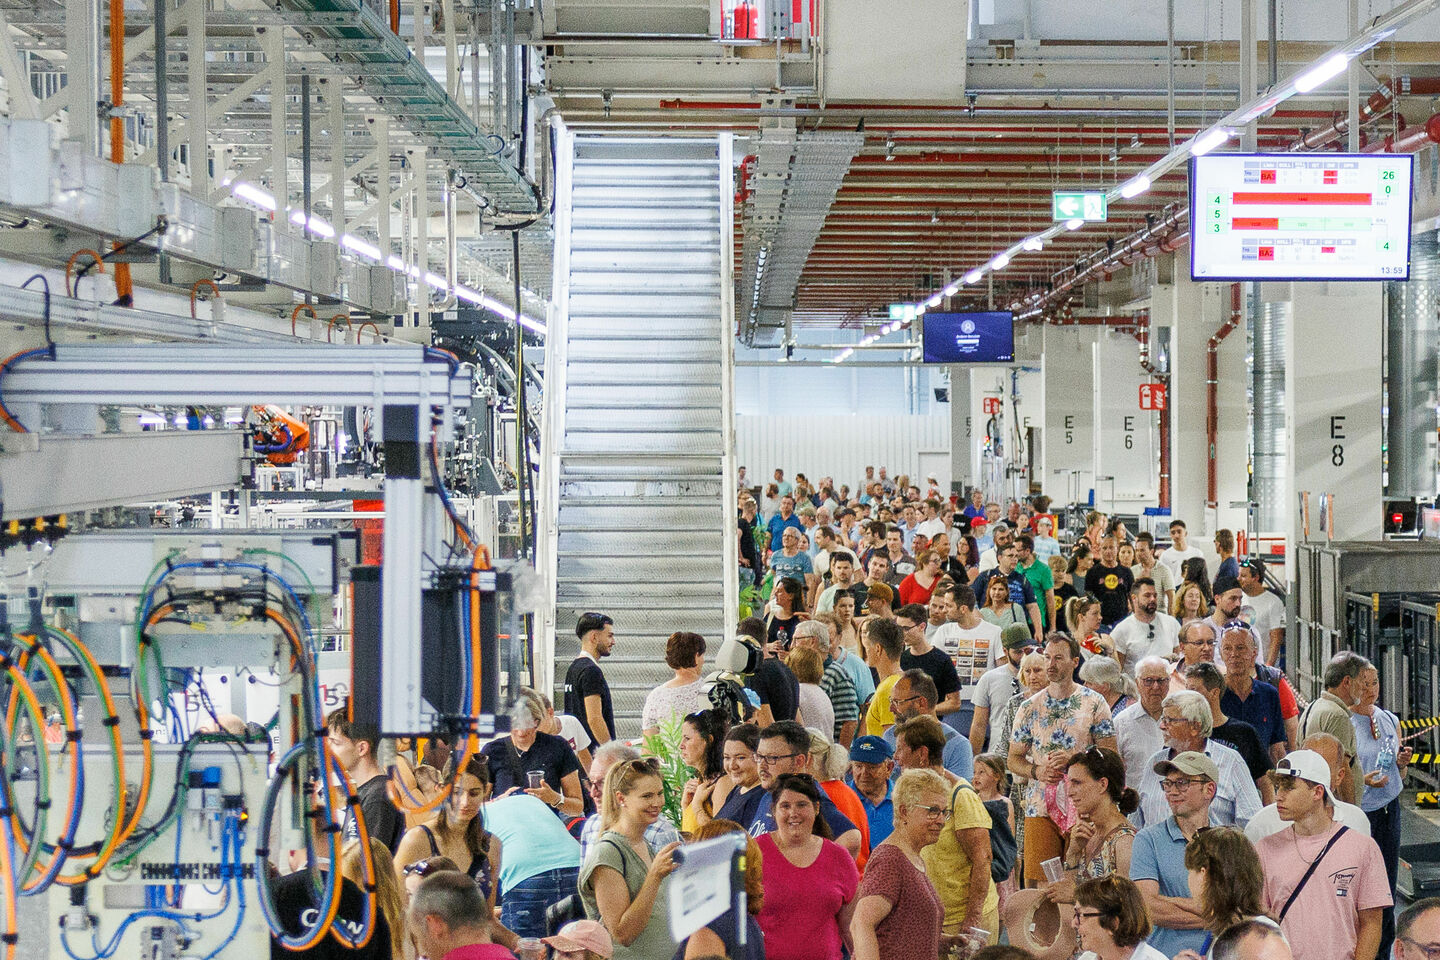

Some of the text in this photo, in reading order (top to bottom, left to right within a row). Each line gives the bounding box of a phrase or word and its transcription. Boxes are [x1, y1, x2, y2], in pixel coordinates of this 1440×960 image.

[1385, 186, 1391, 194] 0
[1214, 196, 1221, 204] 4
[1214, 210, 1220, 218] 5
[1214, 224, 1220, 232] 3
[1065, 415, 1074, 429] E
[1124, 416, 1134, 431] E
[1331, 416, 1345, 439] E
[1066, 432, 1073, 444] 5
[1125, 434, 1133, 449] 6
[1332, 444, 1344, 467] 8
